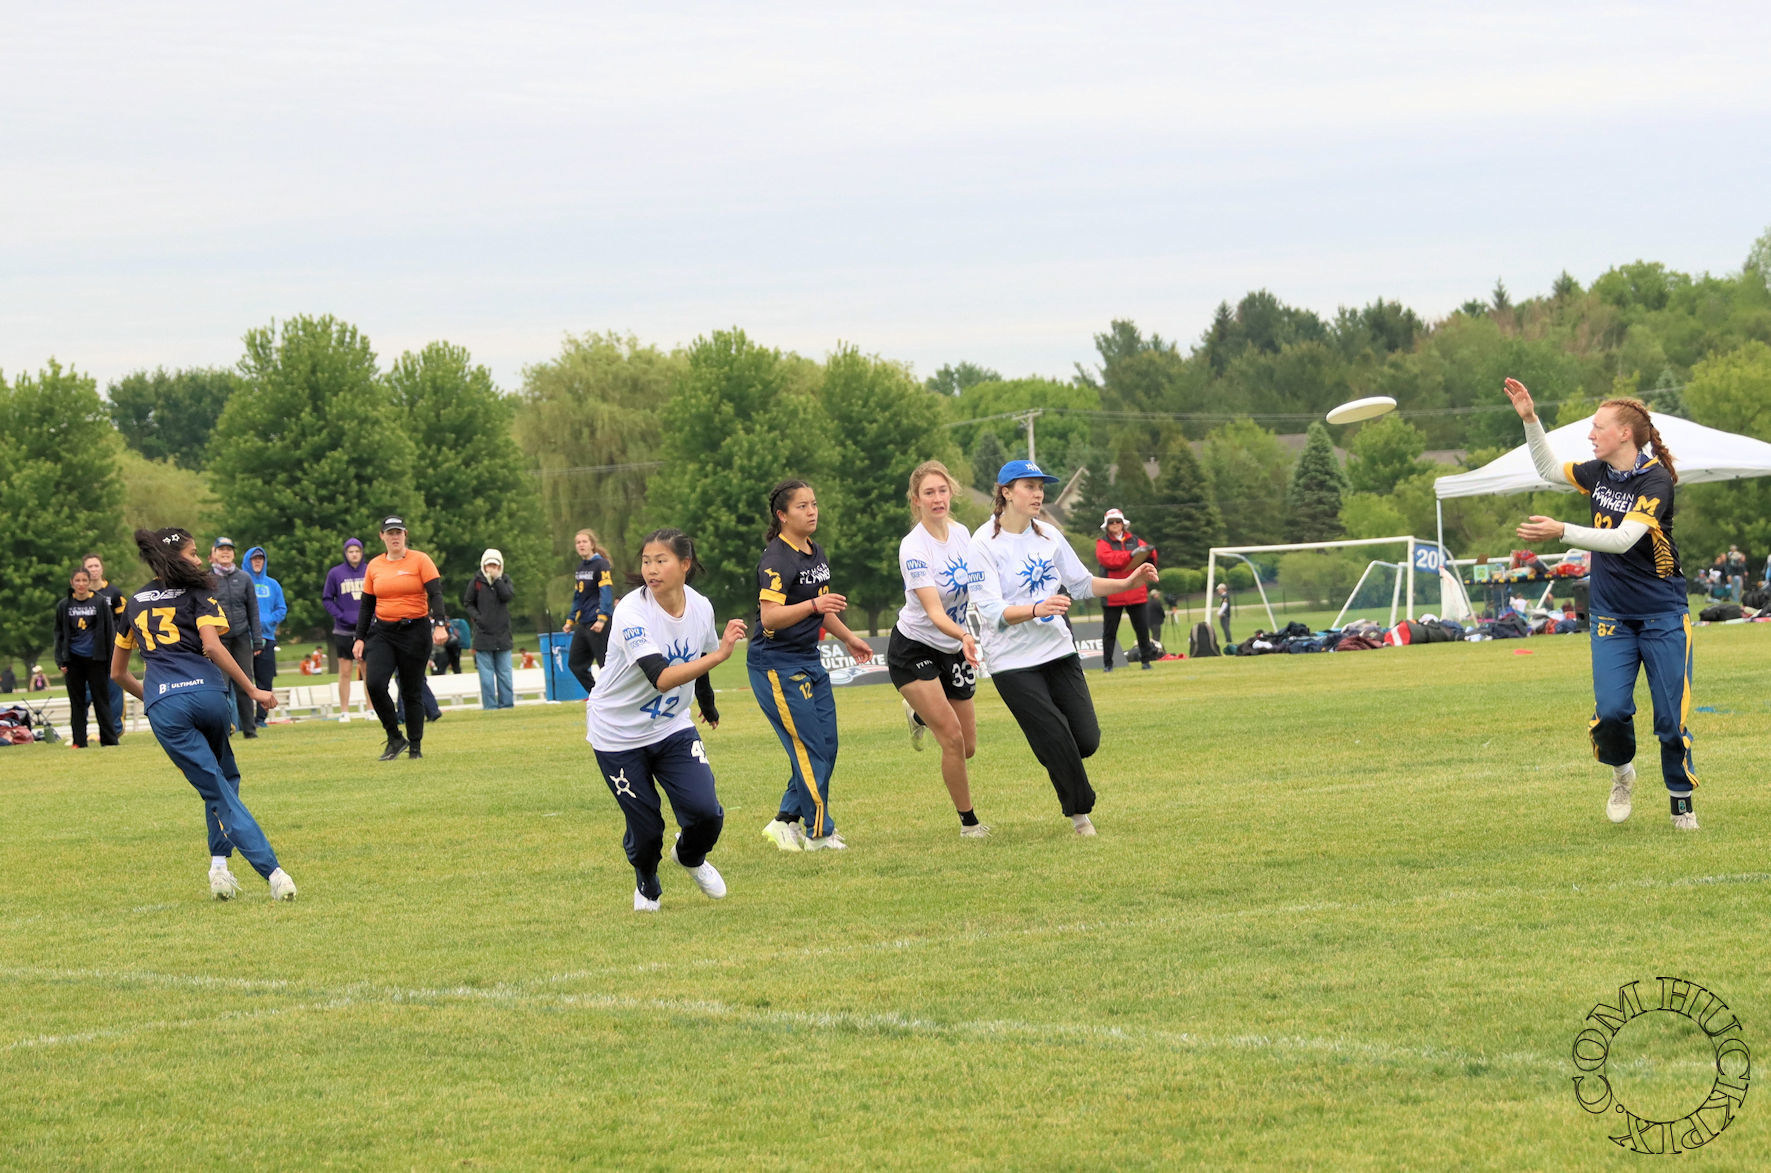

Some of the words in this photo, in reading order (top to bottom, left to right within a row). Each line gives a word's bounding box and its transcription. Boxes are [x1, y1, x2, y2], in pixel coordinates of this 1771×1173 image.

[1633, 495, 1660, 516] M
[1416, 549, 1438, 569] 20
[78, 618, 87, 630] 4
[134, 607, 180, 651] 13
[817, 644, 844, 657] SA
[821, 654, 885, 669] ULTIMTE
[171, 679, 204, 688] ULTIMATE
[952, 661, 976, 688] 33
[799, 682, 812, 700] 12
[640, 695, 680, 719] 42
[690, 740, 710, 764] 4
